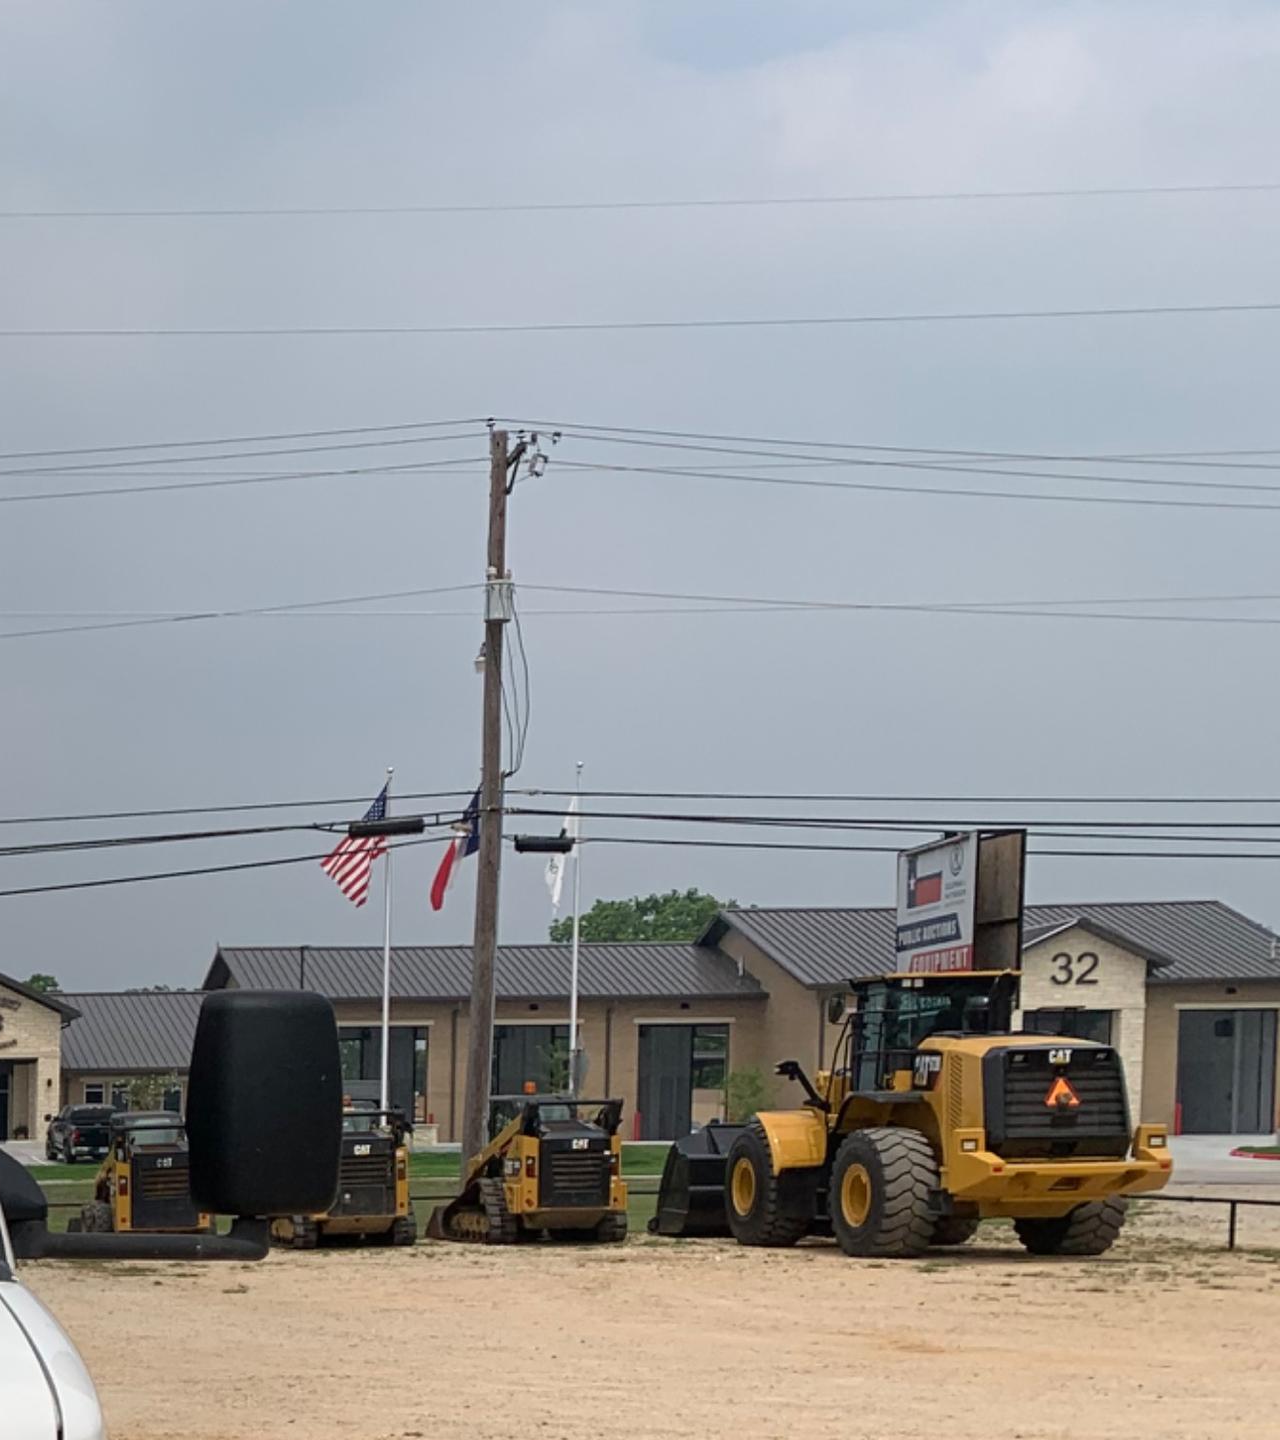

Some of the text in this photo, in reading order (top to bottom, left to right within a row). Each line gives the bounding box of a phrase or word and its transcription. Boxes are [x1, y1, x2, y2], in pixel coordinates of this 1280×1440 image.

[913, 948, 969, 973] EQUIPMENT
[1051, 951, 1099, 985] 32
[1049, 1049, 1072, 1064] CAT
